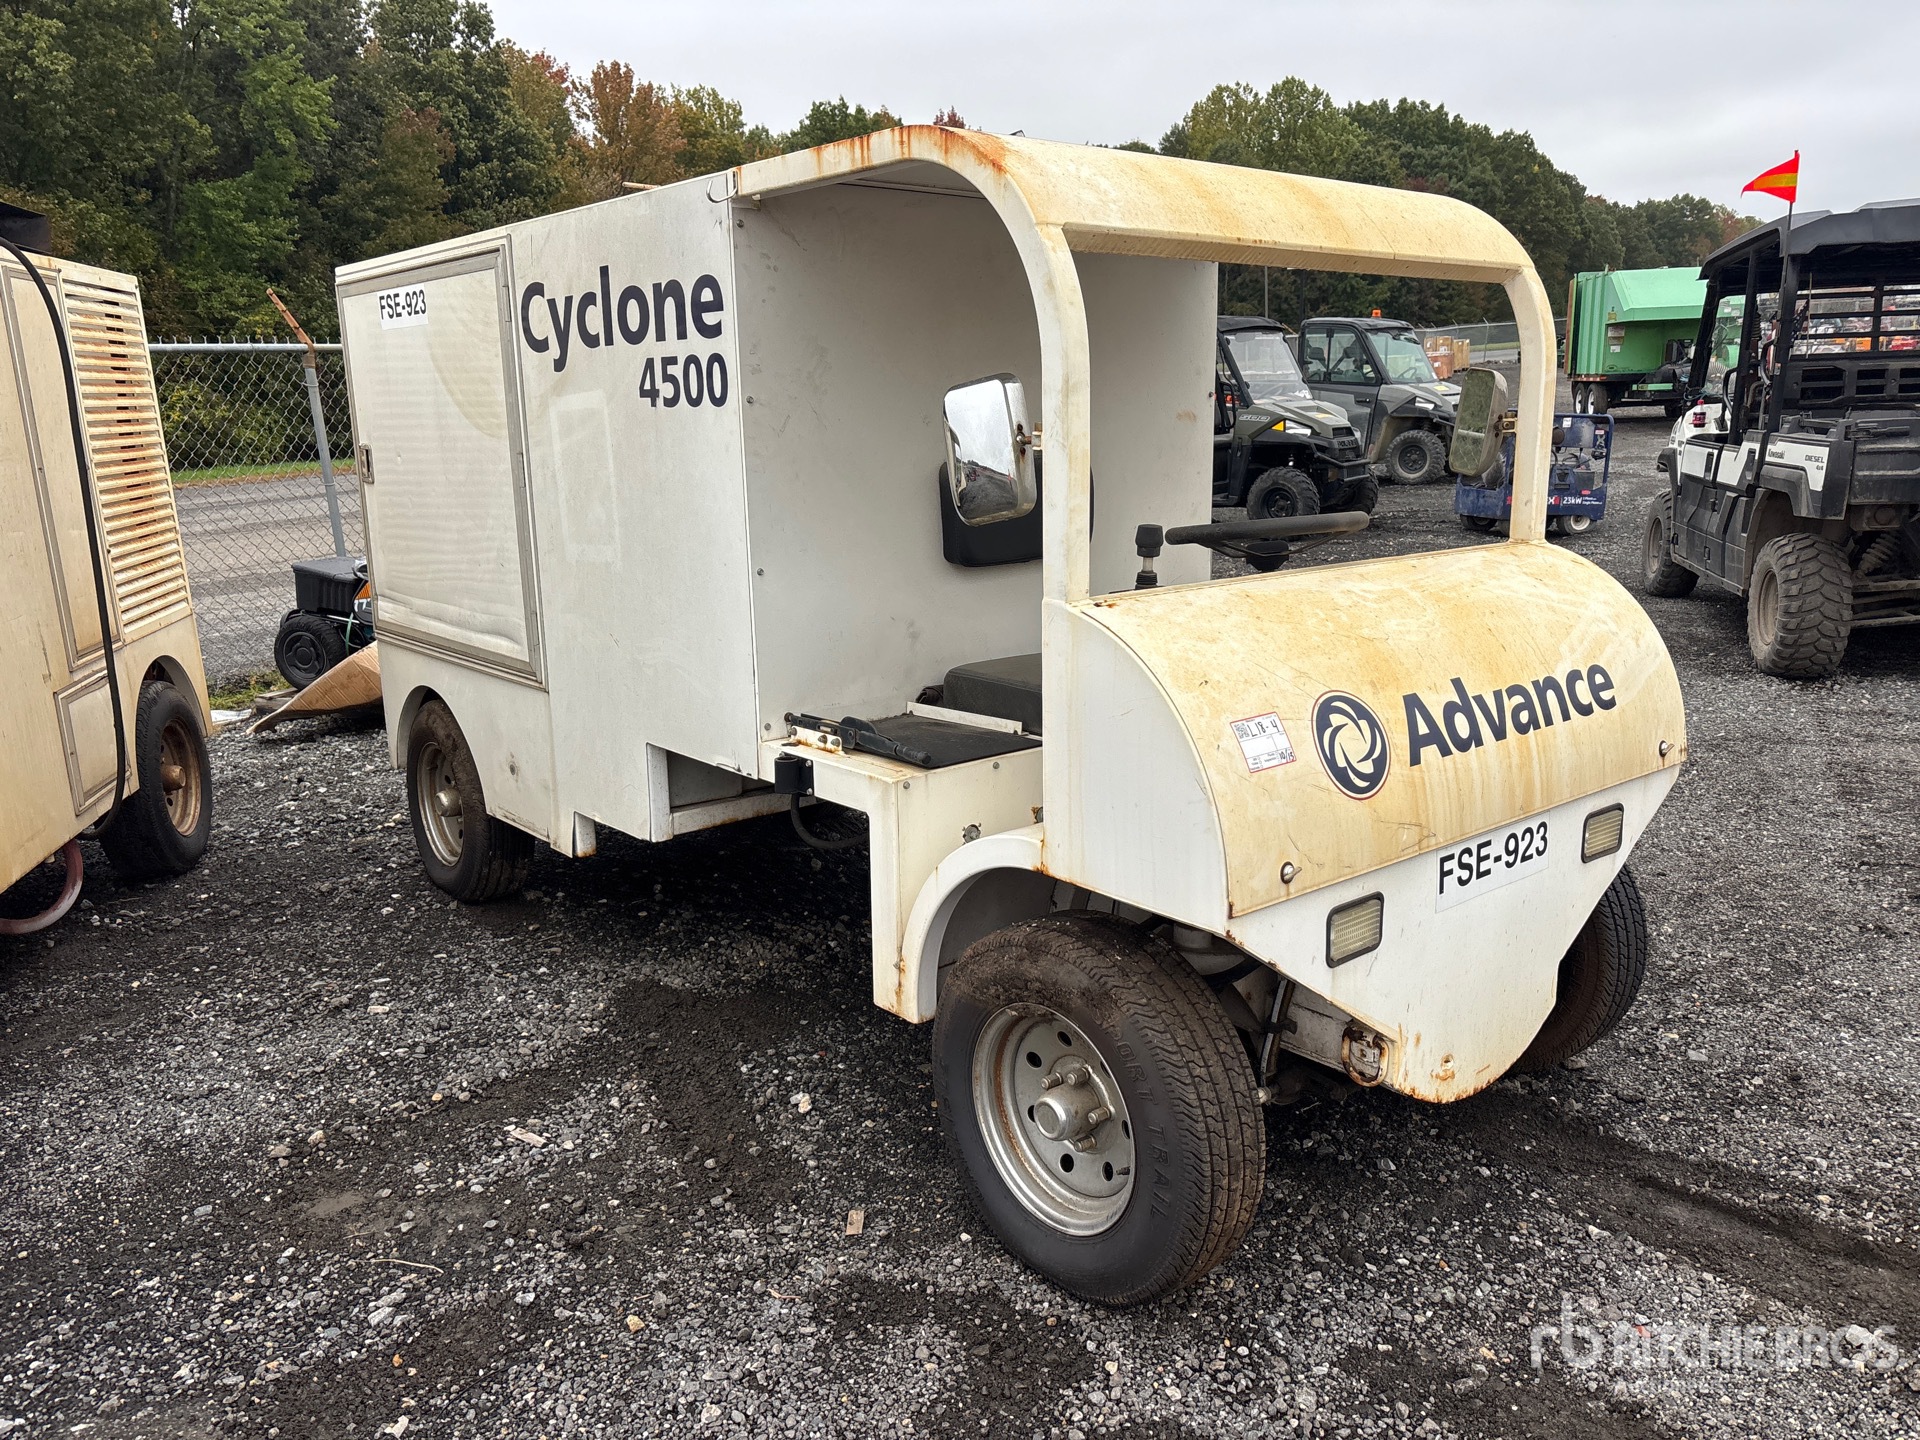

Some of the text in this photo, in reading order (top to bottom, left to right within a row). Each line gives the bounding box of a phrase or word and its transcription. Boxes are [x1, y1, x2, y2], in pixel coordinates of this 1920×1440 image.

[379, 289, 427, 320] FSE-923
[521, 265, 724, 372] Cyclone
[639, 352, 729, 408] 4500
[1804, 454, 1825, 464] DIESEL
[1402, 664, 1617, 767] Advance
[1439, 821, 1549, 895] FSE-923
[1144, 1123, 1171, 1219] TRAIL
